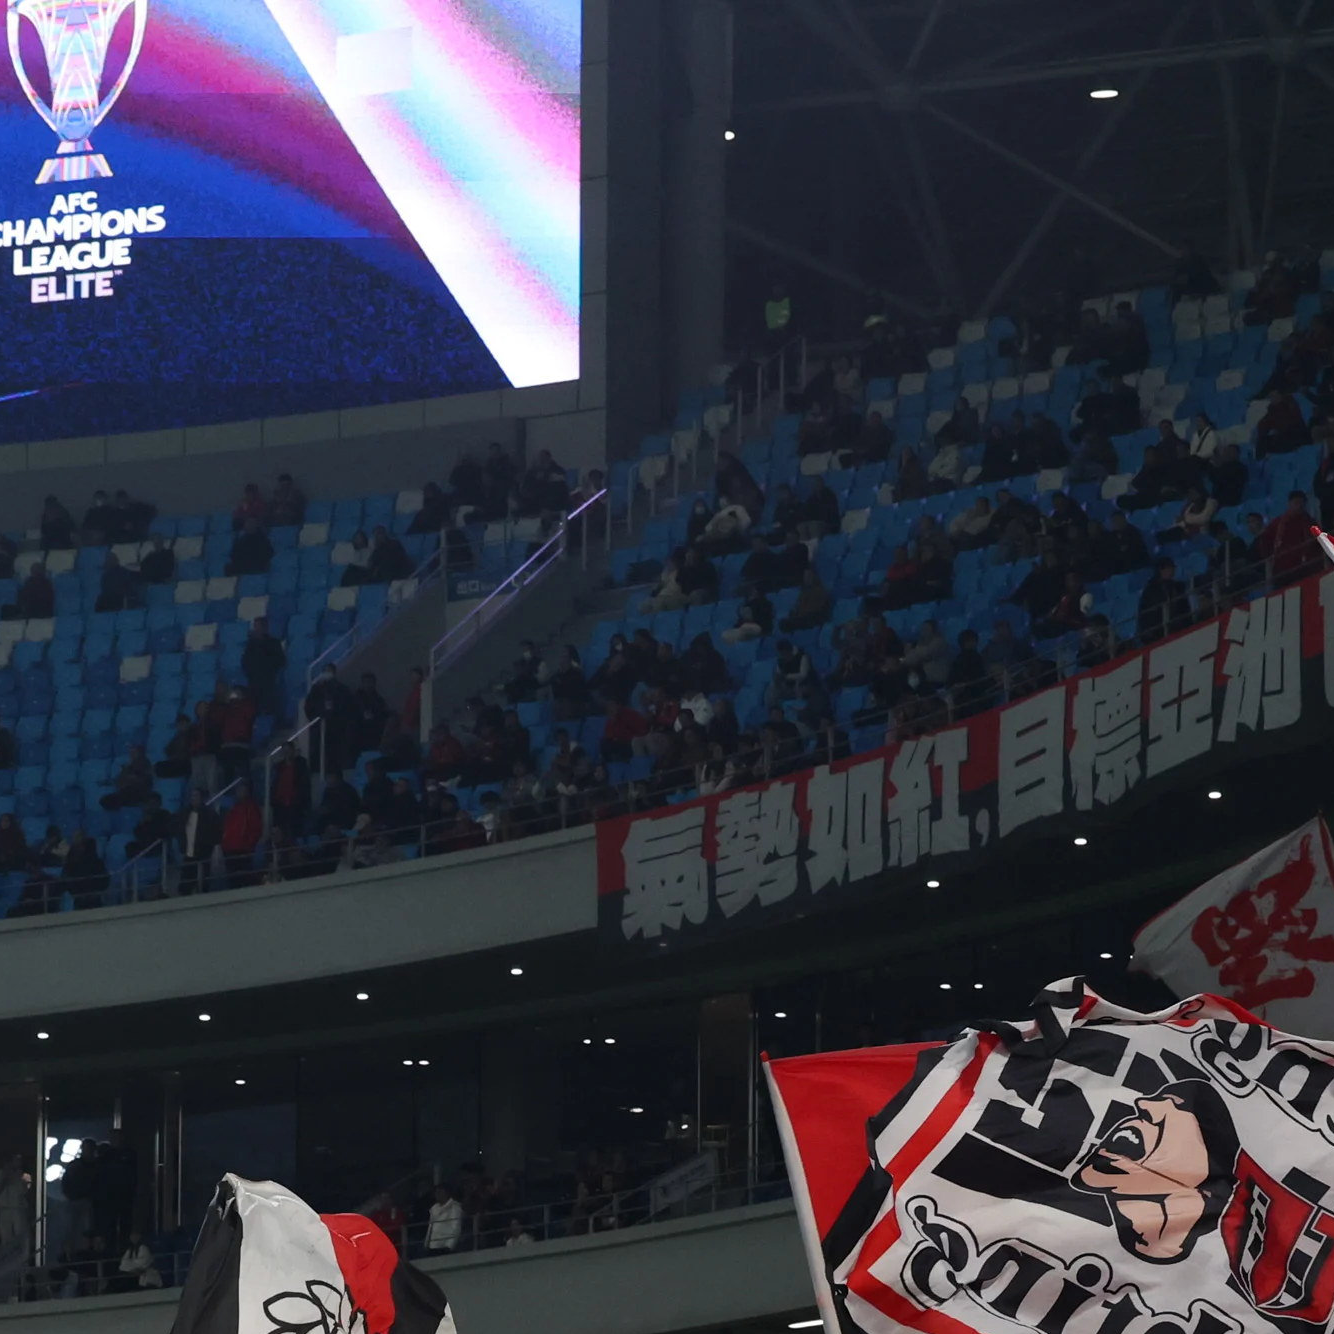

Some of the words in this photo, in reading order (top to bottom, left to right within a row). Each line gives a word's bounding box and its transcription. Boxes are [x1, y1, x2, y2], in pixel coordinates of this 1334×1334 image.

[49, 191, 98, 217] AFC
[13, 236, 132, 278] LEAGUE
[30, 271, 115, 305] ELITE
